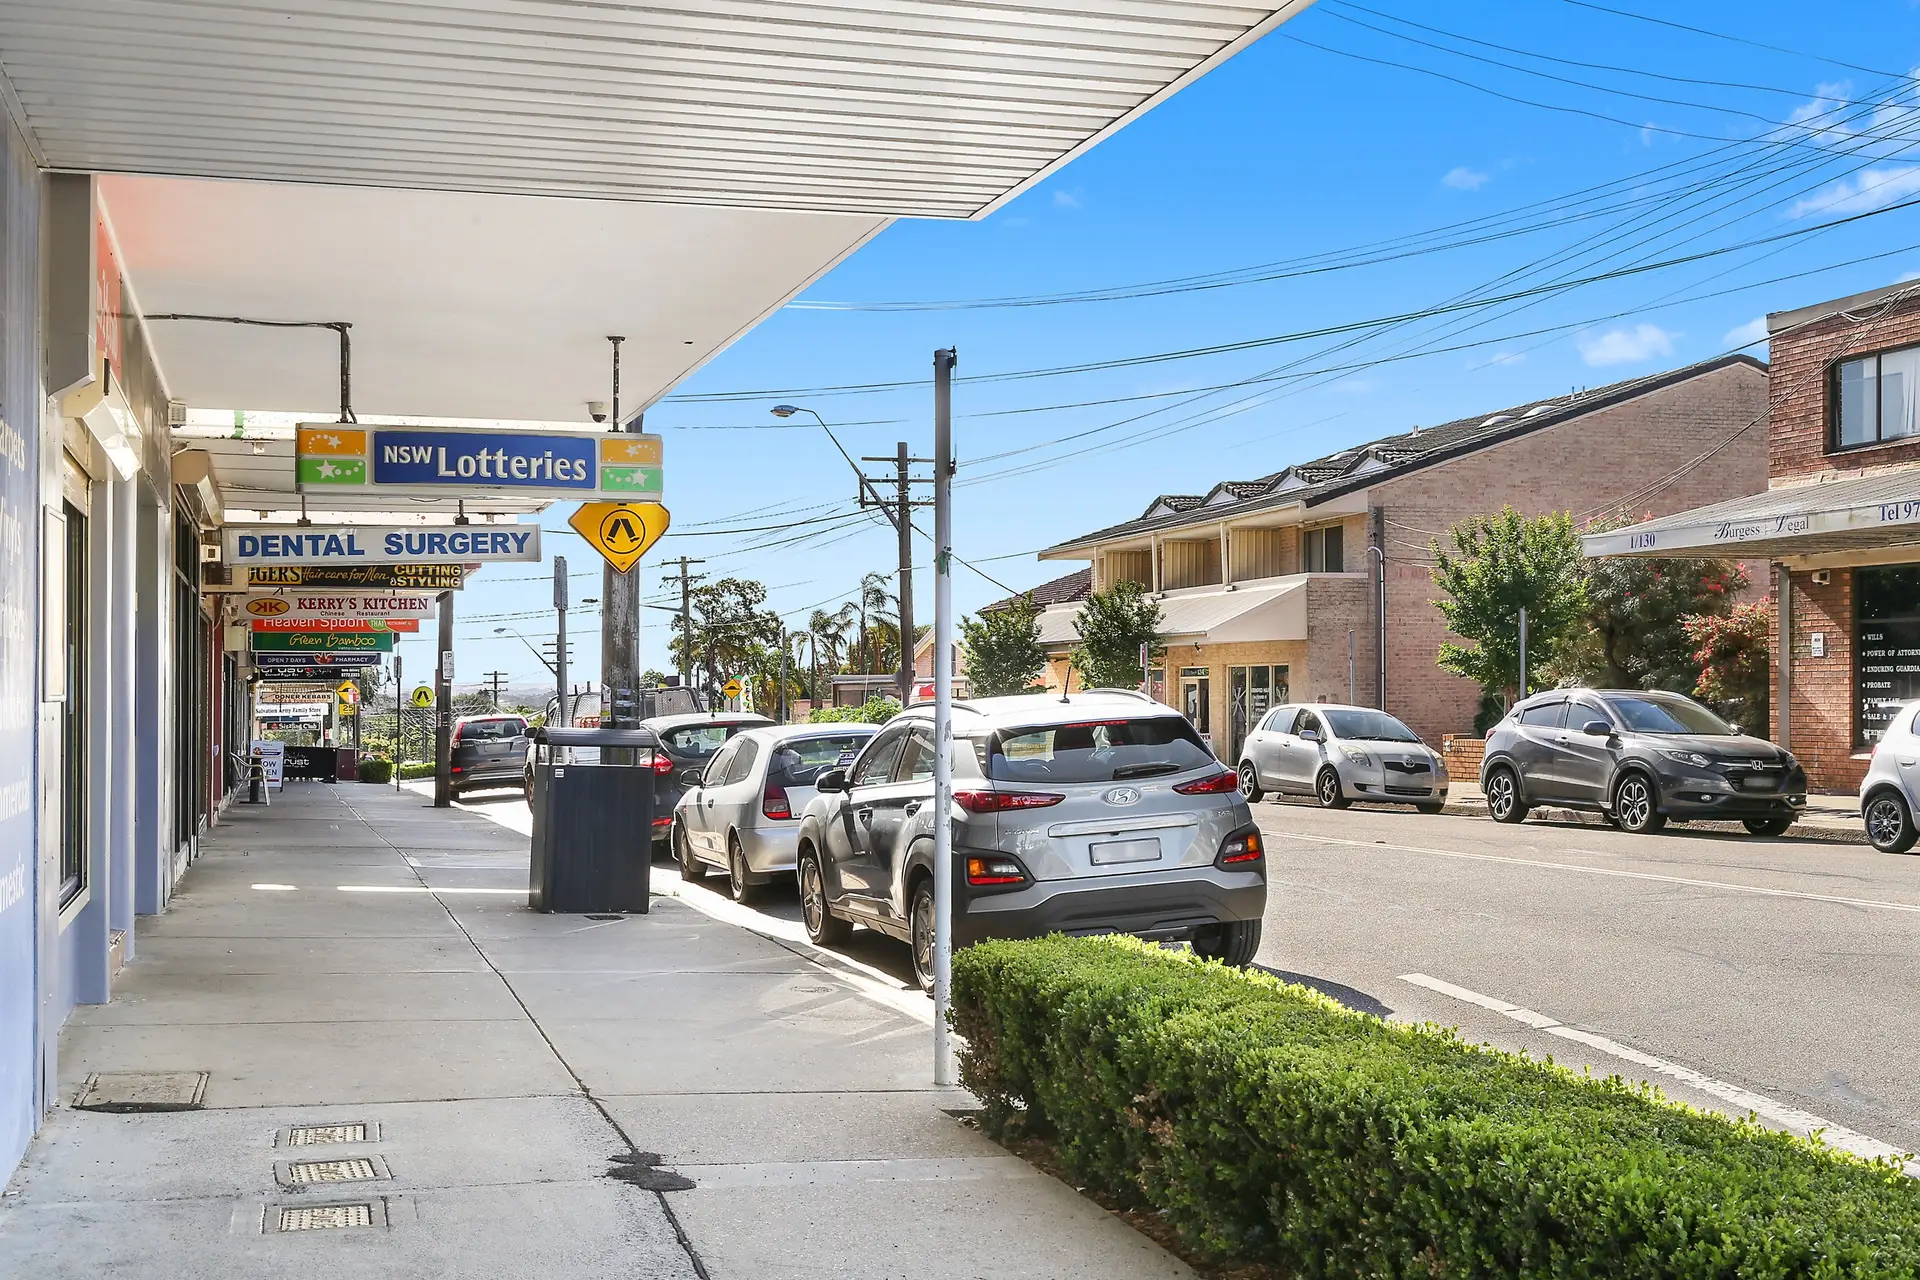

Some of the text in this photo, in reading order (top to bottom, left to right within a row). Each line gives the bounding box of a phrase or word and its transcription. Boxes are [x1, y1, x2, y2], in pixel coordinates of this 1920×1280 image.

[383, 445, 587, 482] NSW Lotteries
[1878, 503, 1900, 521] Tel
[1714, 522, 1760, 540] Burgess
[238, 532, 531, 557] DENTAL SURGERY
[1629, 532, 1656, 549] 1/130
[303, 566, 324, 580] Hair
[324, 571, 348, 579] care
[347, 568, 365, 582] for
[394, 565, 461, 576] CUTTING
[397, 576, 461, 587] STYLING
[297, 597, 428, 610] KERRY'S KITCHEN
[289, 632, 376, 648] Green Bamboo
